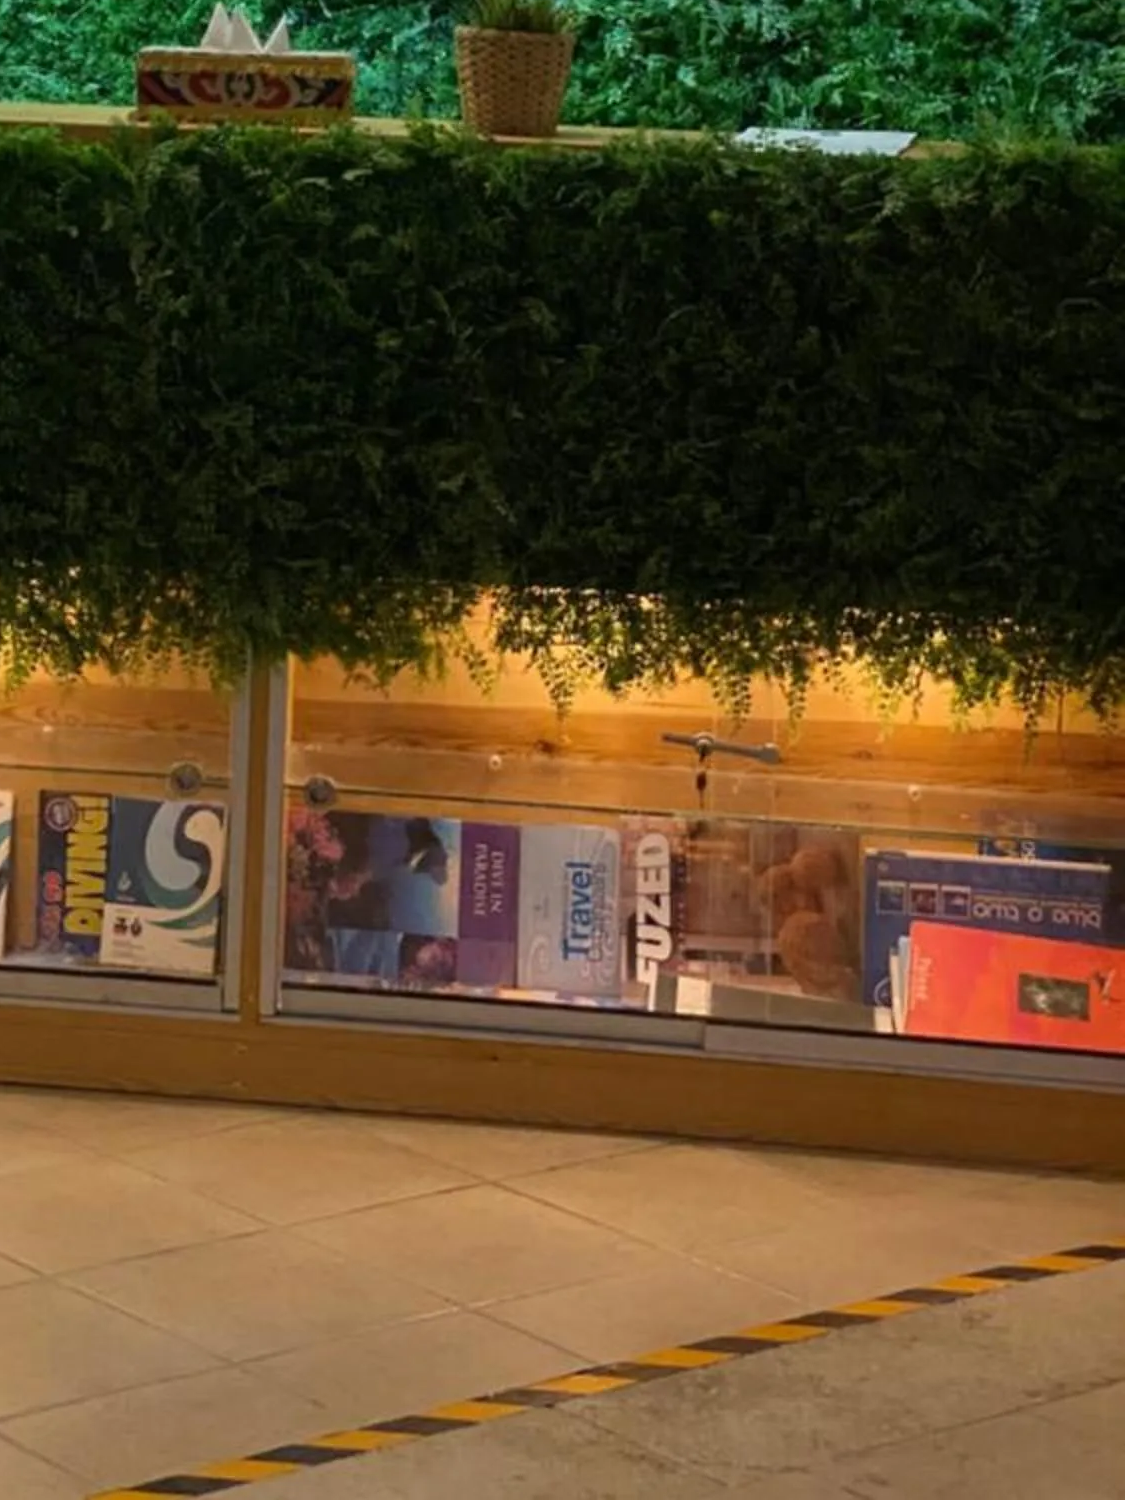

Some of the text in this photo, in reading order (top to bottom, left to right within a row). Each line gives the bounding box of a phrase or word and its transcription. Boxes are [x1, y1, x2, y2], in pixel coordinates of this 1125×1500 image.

[489, 893, 504, 913] IN
[561, 861, 592, 961] Travel
[635, 832, 673, 1012] FUZED
